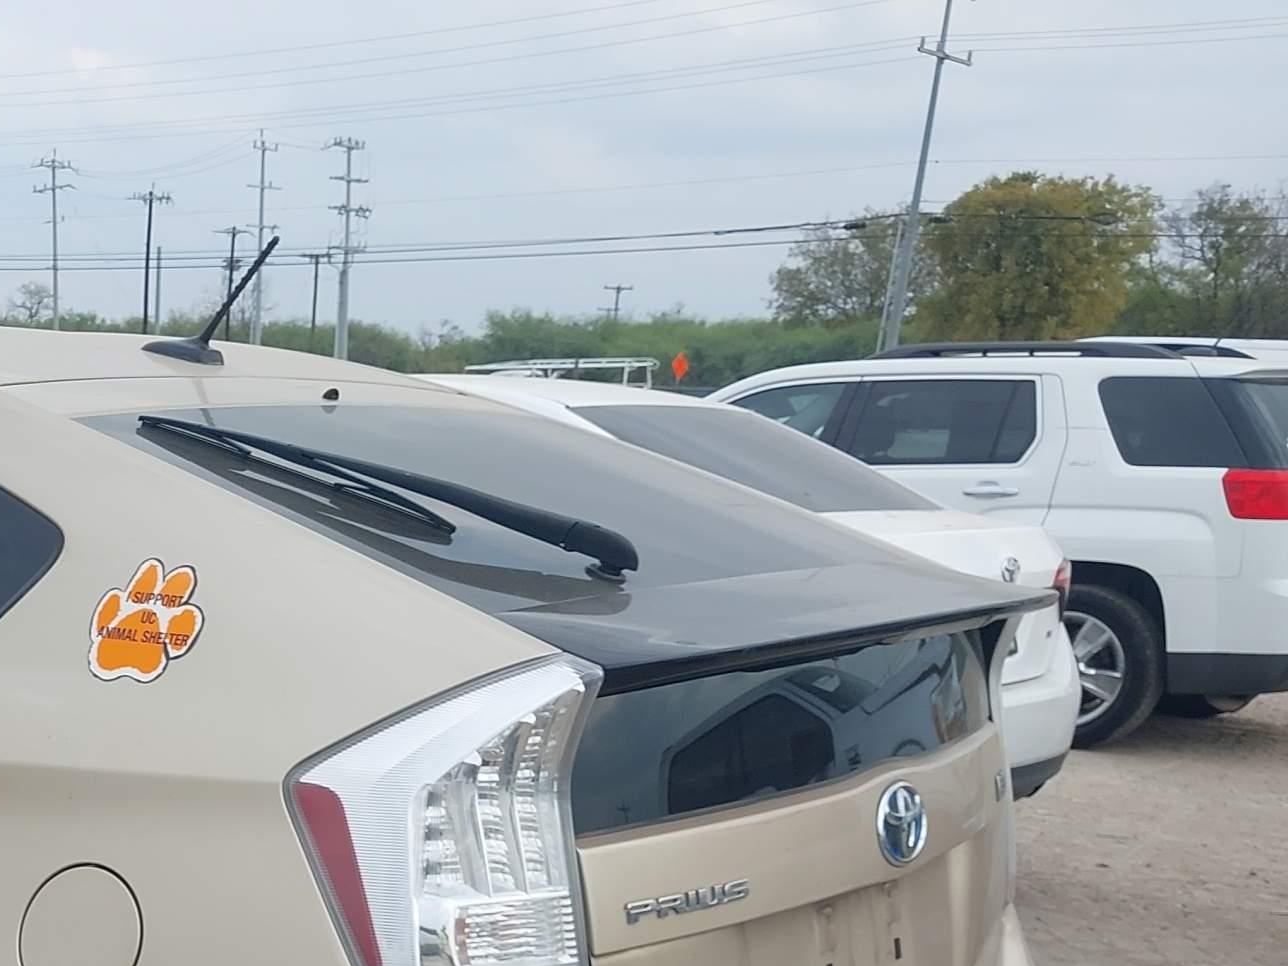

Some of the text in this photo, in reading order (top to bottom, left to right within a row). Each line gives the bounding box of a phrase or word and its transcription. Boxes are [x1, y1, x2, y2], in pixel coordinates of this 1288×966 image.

[132, 591, 184, 607] SUPPORT
[140, 611, 157, 625] UC
[96, 625, 190, 647] ANIMAL SHELTER
[624, 878, 749, 925] PRIUS
